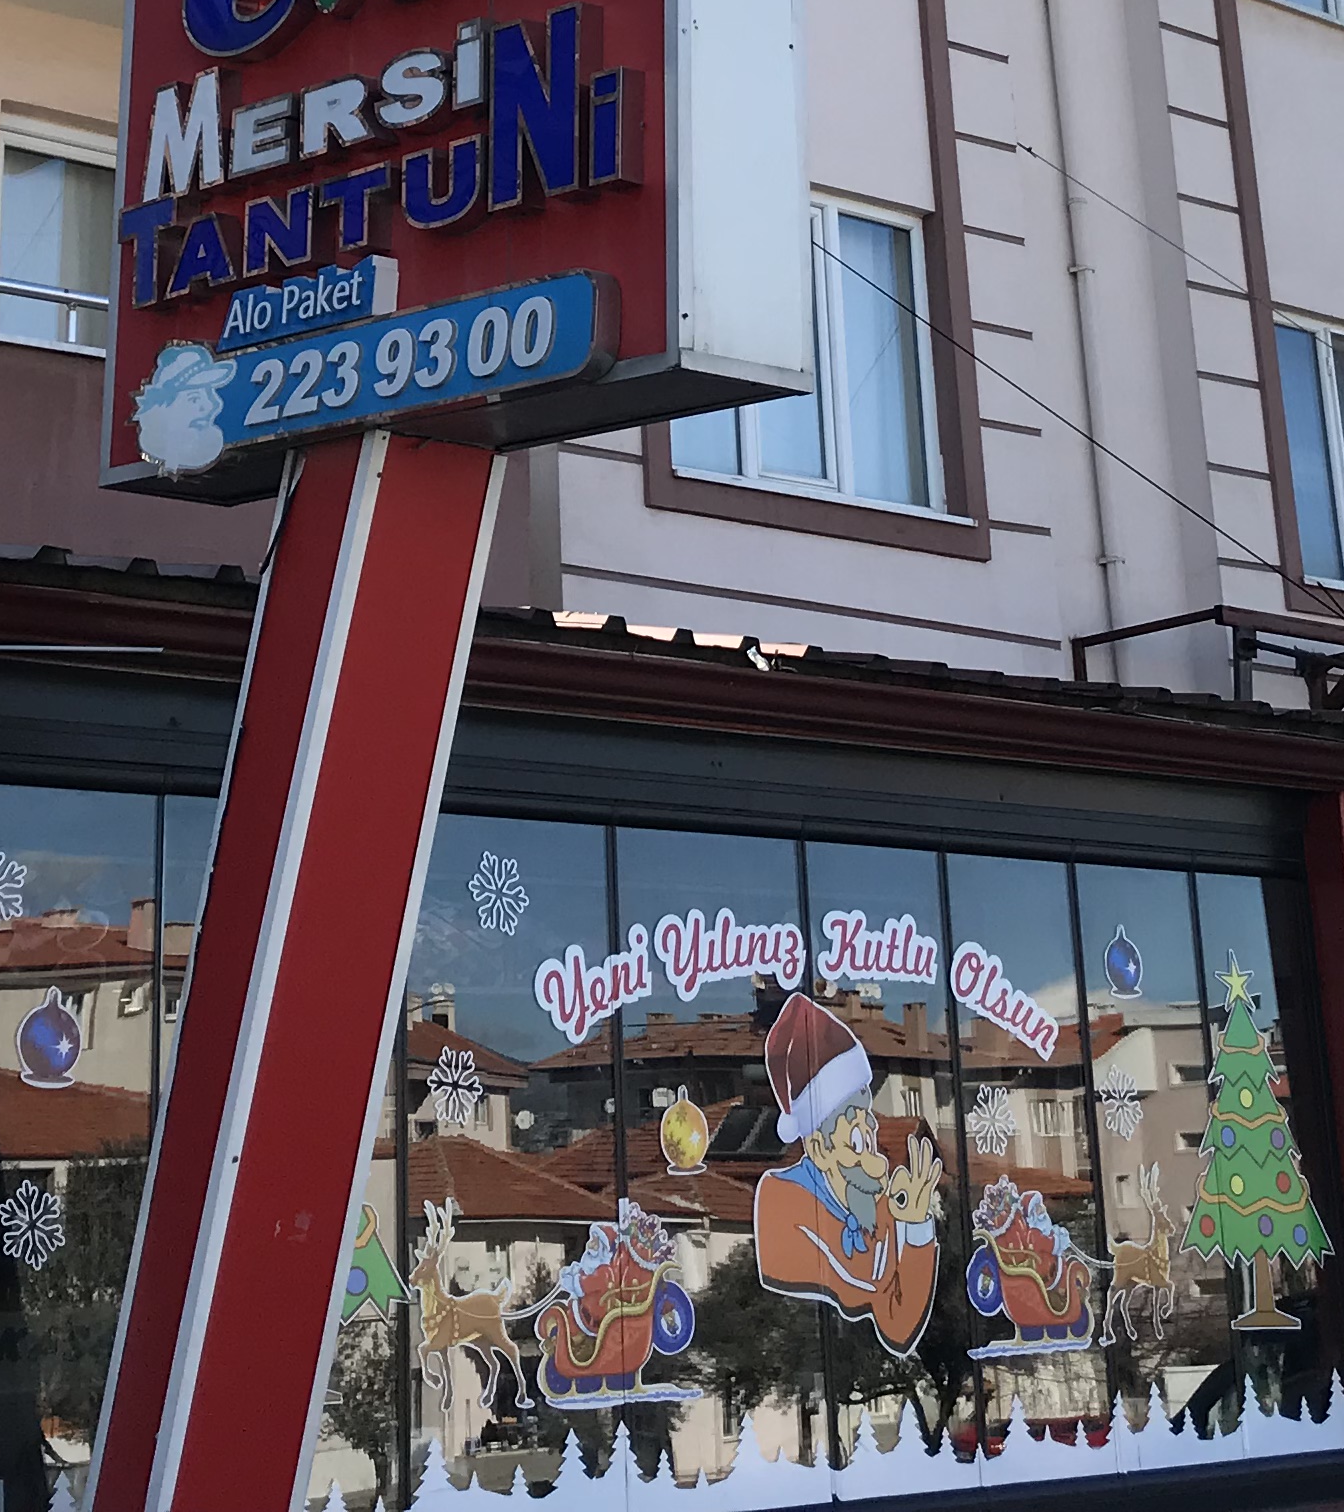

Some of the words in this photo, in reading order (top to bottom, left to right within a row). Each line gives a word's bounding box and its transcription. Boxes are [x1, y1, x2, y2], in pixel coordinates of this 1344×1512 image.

[223, 297, 272, 339] Alo
[282, 271, 363, 324] Paket
[244, 341, 360, 426] 223
[373, 319, 456, 397] 93
[467, 296, 553, 377] 00
[541, 933, 648, 1037] Yeni
[825, 915, 935, 979] Kutlu
[954, 948, 1056, 1054] Olsun
